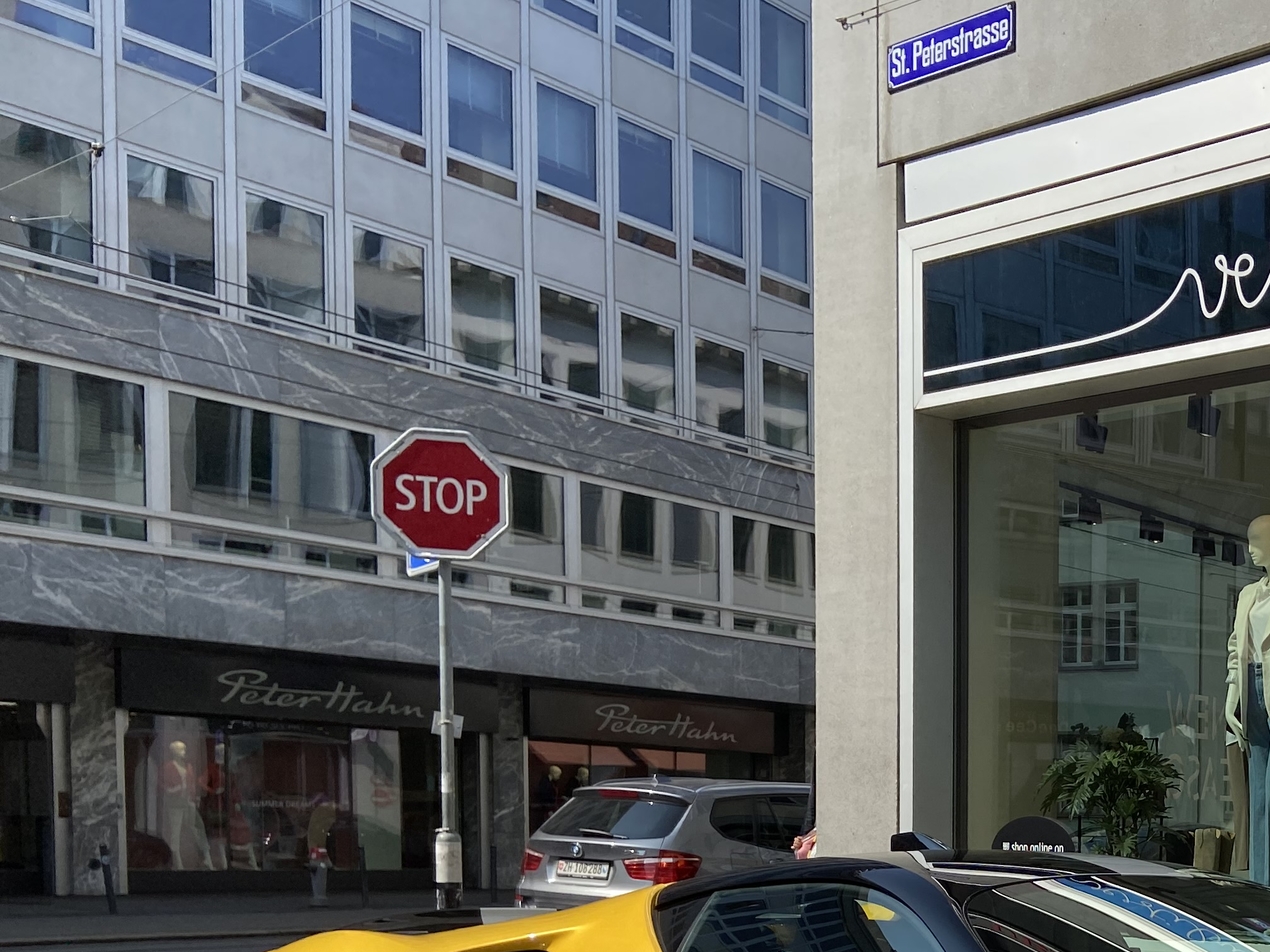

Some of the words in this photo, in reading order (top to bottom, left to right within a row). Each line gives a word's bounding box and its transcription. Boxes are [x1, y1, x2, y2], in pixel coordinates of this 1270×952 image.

[891, 47, 910, 78] St.
[912, 18, 1009, 71] Peterstrasse
[394, 473, 488, 516] STOP
[217, 668, 322, 708] Peter
[325, 680, 424, 718] Hahn
[595, 703, 667, 735] Peter
[668, 712, 738, 743] Hahn
